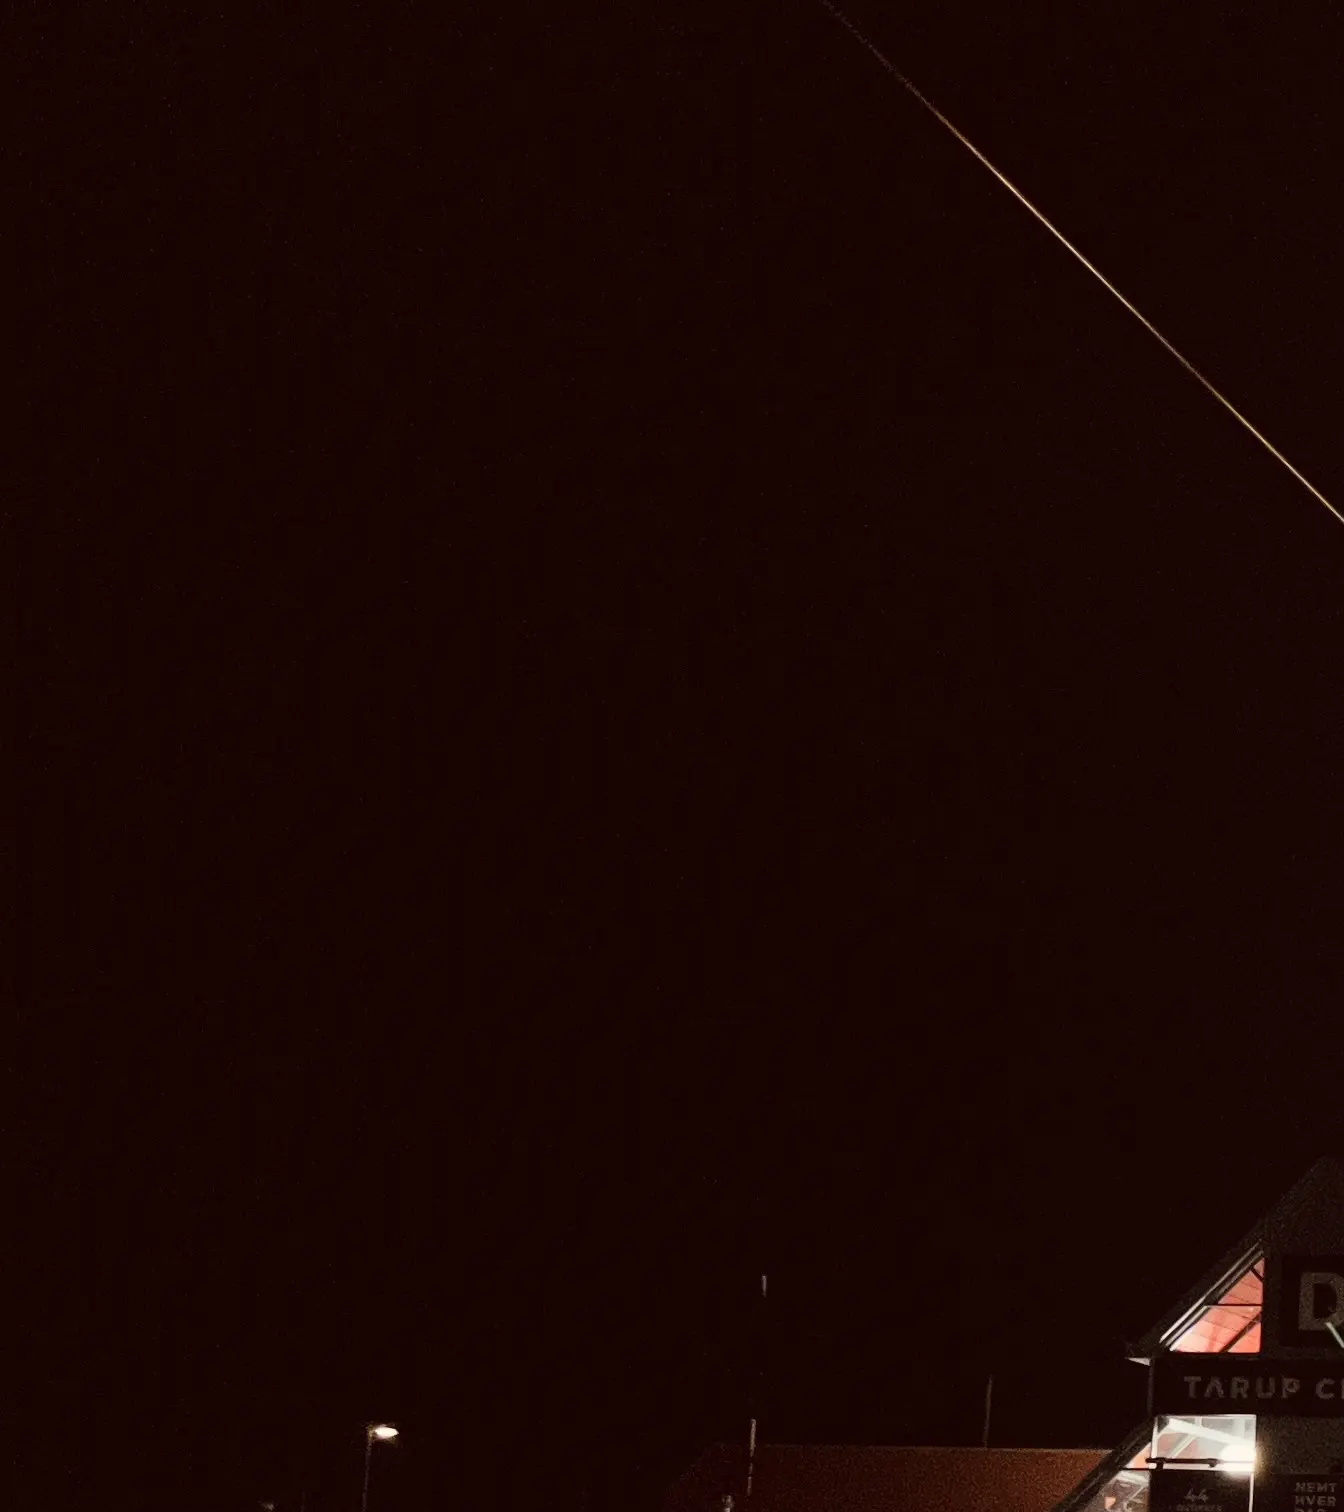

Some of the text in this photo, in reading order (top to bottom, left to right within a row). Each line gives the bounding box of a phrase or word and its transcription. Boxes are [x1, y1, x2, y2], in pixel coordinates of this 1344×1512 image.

[1183, 1375, 1301, 1400] TARUP
[1295, 1482, 1337, 1493] NEMT
[1295, 1495, 1337, 1507] HVER
